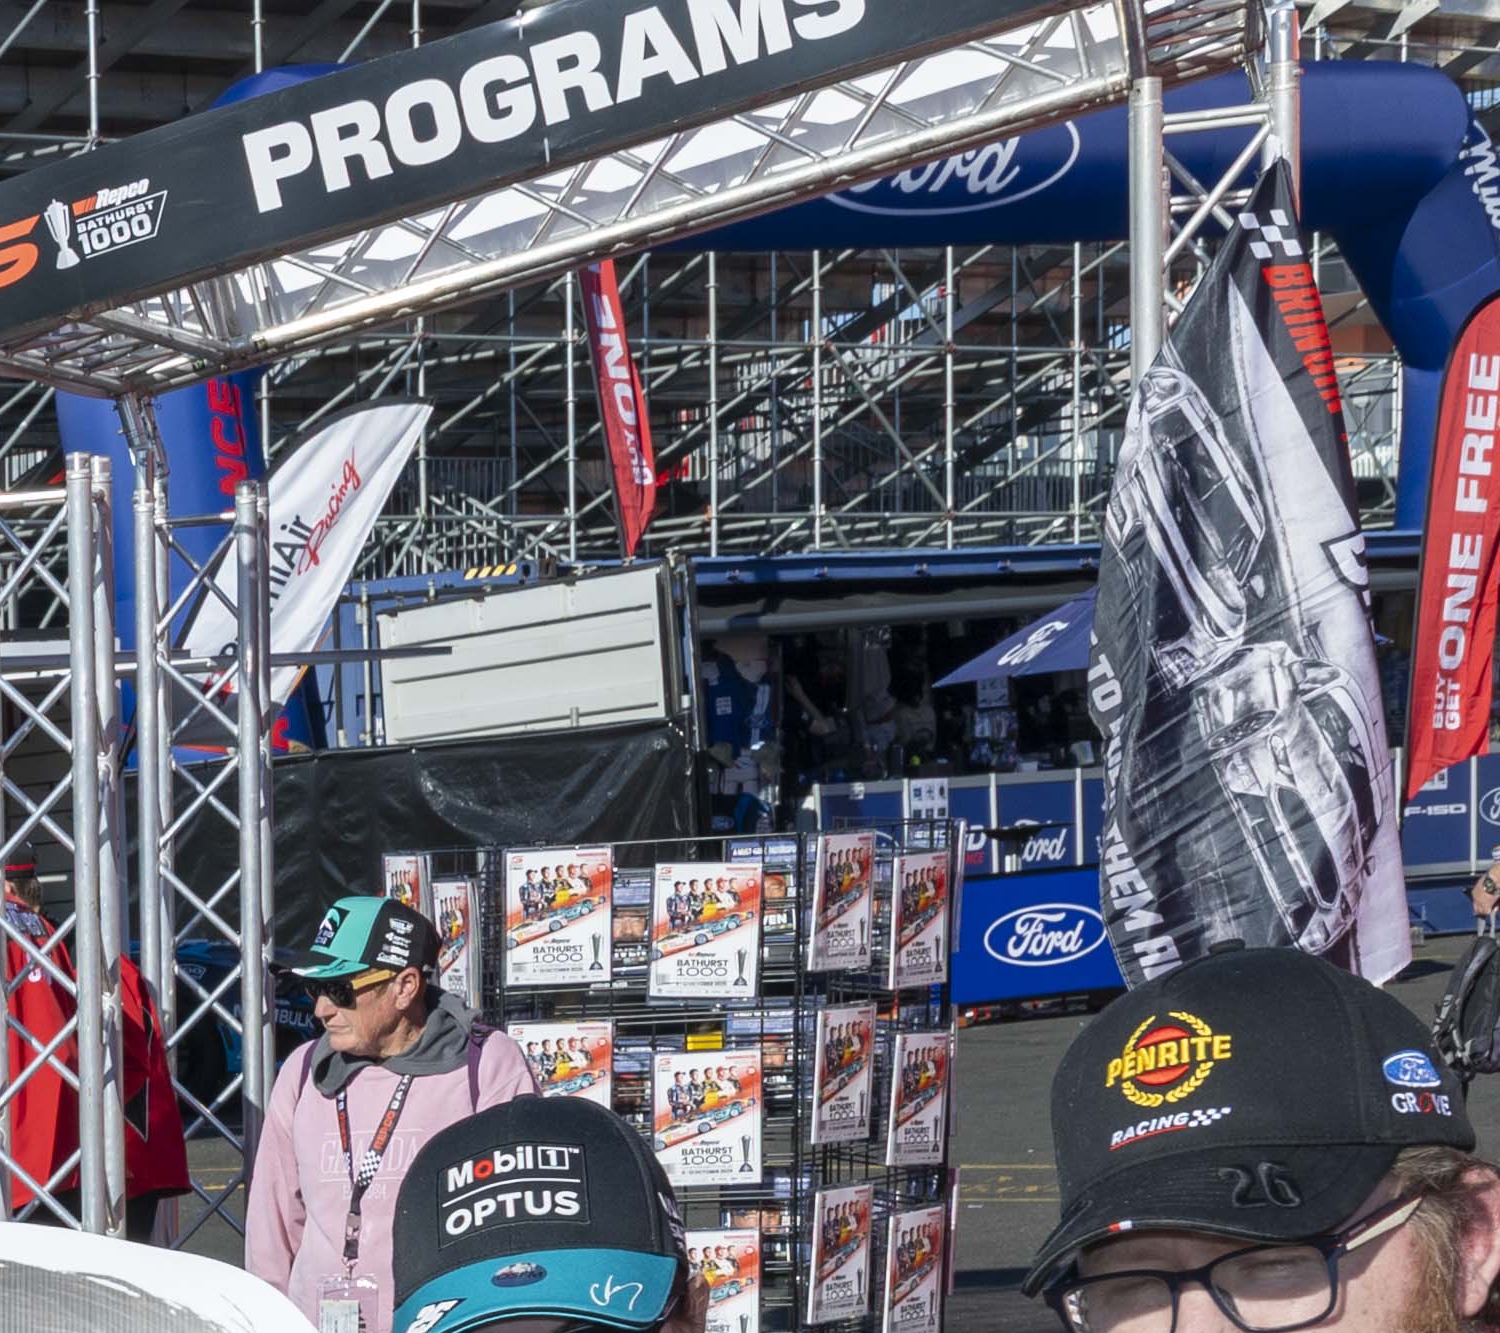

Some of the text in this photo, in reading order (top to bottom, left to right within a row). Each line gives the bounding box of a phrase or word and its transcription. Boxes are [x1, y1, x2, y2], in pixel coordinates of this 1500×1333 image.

[244, 0, 866, 212] PROGRAMS
[96, 178, 149, 209] Repco
[76, 200, 155, 234] BATHURST
[79, 213, 153, 255] 1000
[297, 446, 362, 576] Racing
[1438, 354, 1500, 730] GET ONE FREE
[1432, 676, 1447, 729] BUY
[532, 944, 583, 955] BATHURST
[1007, 912, 1085, 958] Ford
[677, 959, 728, 968] BATHURST
[1105, 1035, 1232, 1087] PENRITE
[1391, 1092, 1452, 1117] GROVE
[370, 1109, 397, 1151] REPCO
[1111, 1111, 1190, 1146] RACING
[447, 1145, 534, 1192] Mobil
[681, 1146, 732, 1156] BATHURST
[681, 1155, 732, 1165] 1000
[1218, 1161, 1300, 1208] 26
[445, 1190, 580, 1236] OPTUS
